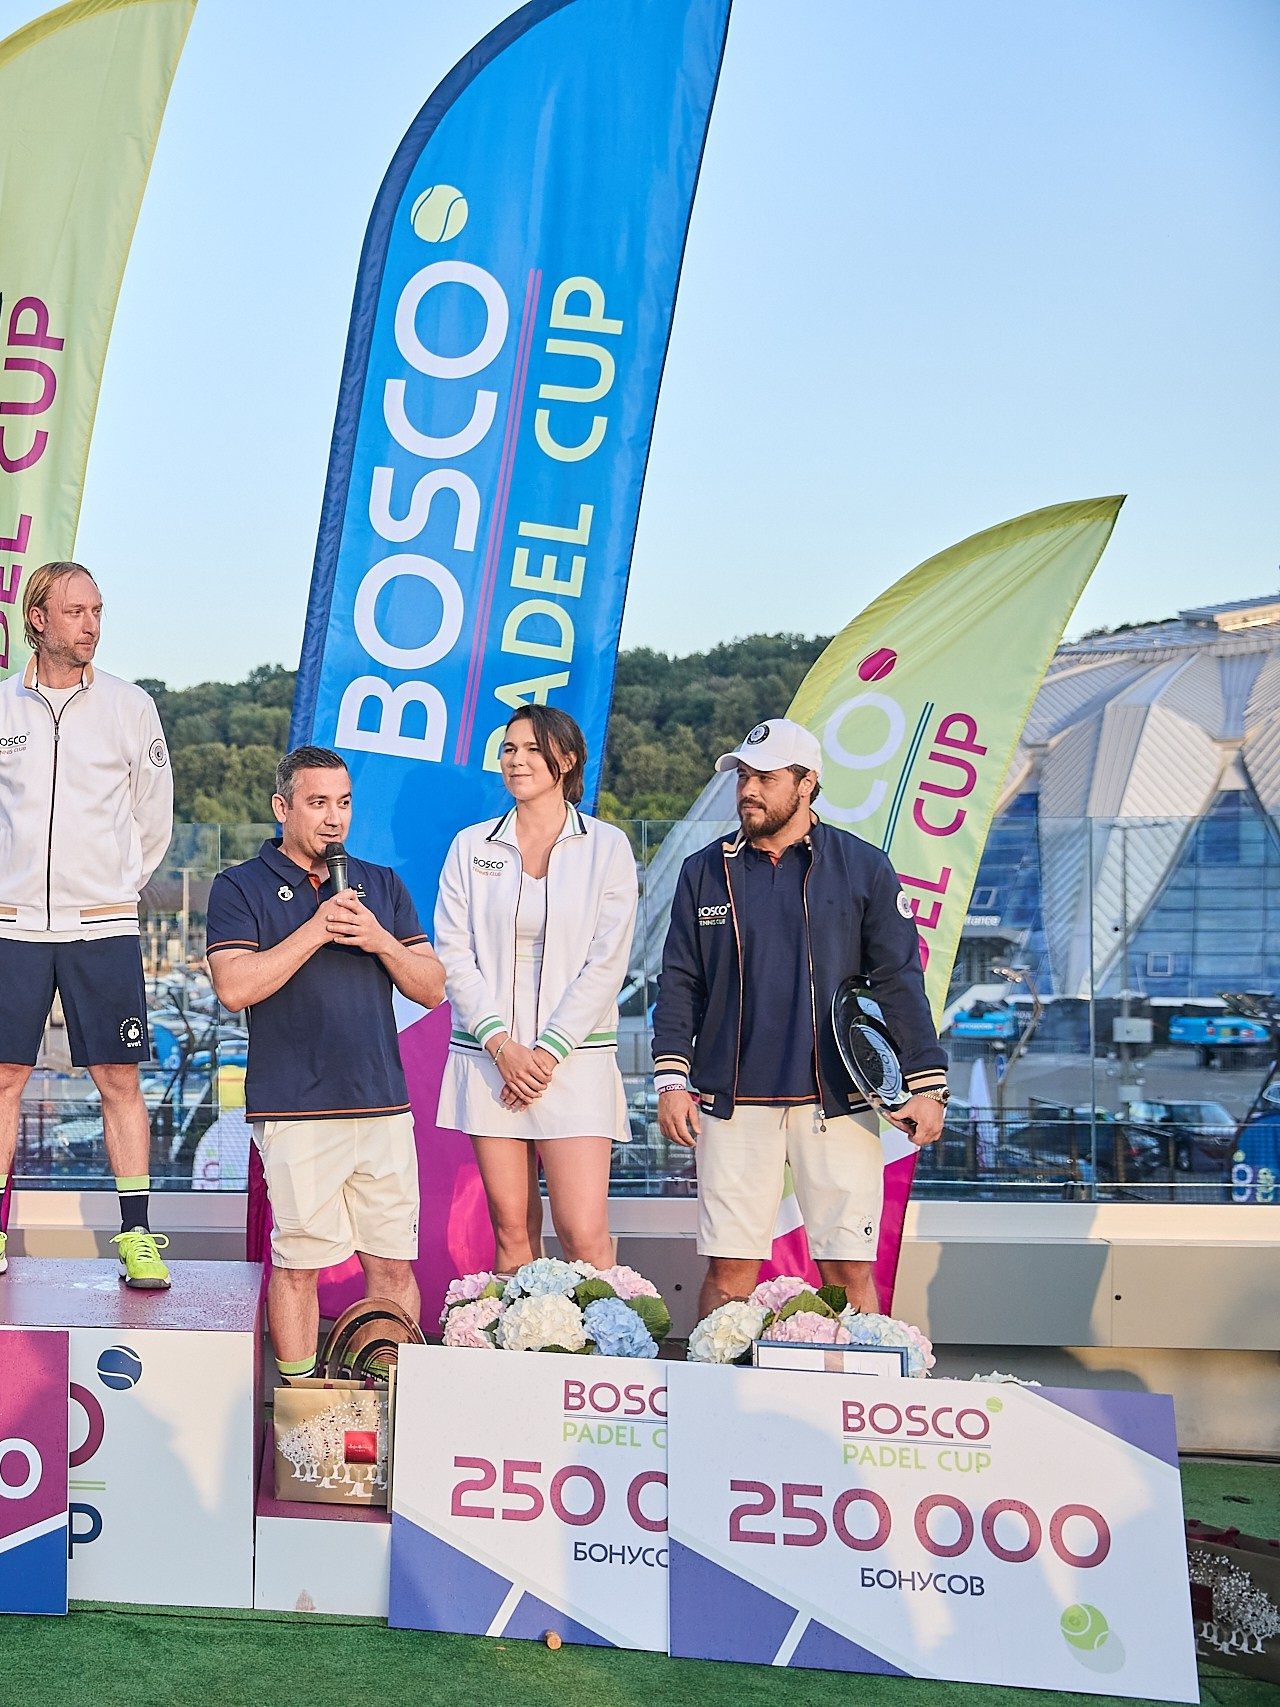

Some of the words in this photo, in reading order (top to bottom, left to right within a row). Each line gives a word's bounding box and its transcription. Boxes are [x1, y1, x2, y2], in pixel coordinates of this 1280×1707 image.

[534, 276, 624, 463] CUP
[334, 260, 509, 764] BOSCO
[912, 712, 988, 837] CUP
[473, 856, 504, 869] BOSCO
[563, 1379, 668, 1417] BOSC
[562, 1421, 642, 1448] PADEL
[841, 1400, 991, 1441] BOSCO
[842, 1443, 927, 1471] PADEL
[936, 1449, 992, 1474] CUP
[450, 1456, 606, 1527] 250
[728, 1479, 892, 1552] 250
[913, 1493, 1112, 1569] 000
[860, 1566, 986, 1598] БОНУСОВ
